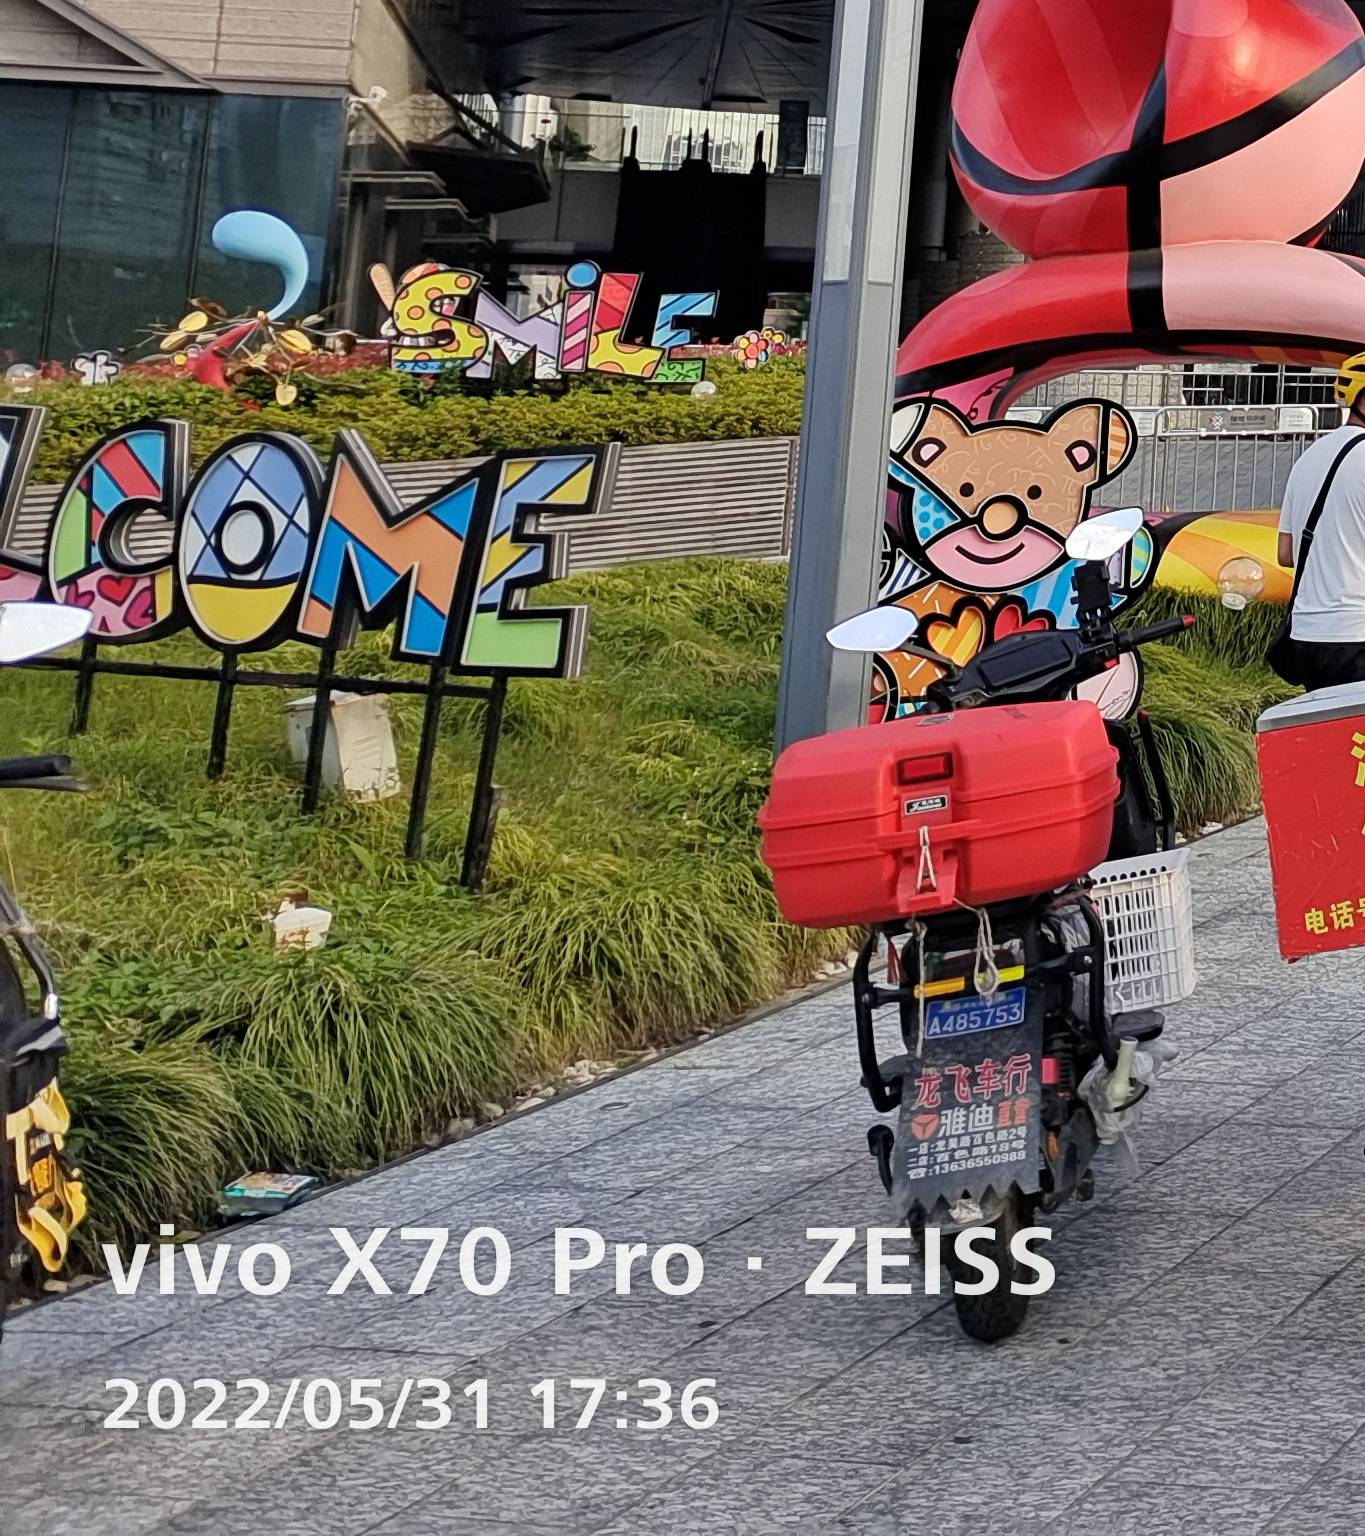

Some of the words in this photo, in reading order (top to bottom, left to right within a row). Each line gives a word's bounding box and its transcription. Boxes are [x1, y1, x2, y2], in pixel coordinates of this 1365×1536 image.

[927, 1002, 1021, 1037] A485753
[910, 1052, 1032, 1111] 龙飞车行
